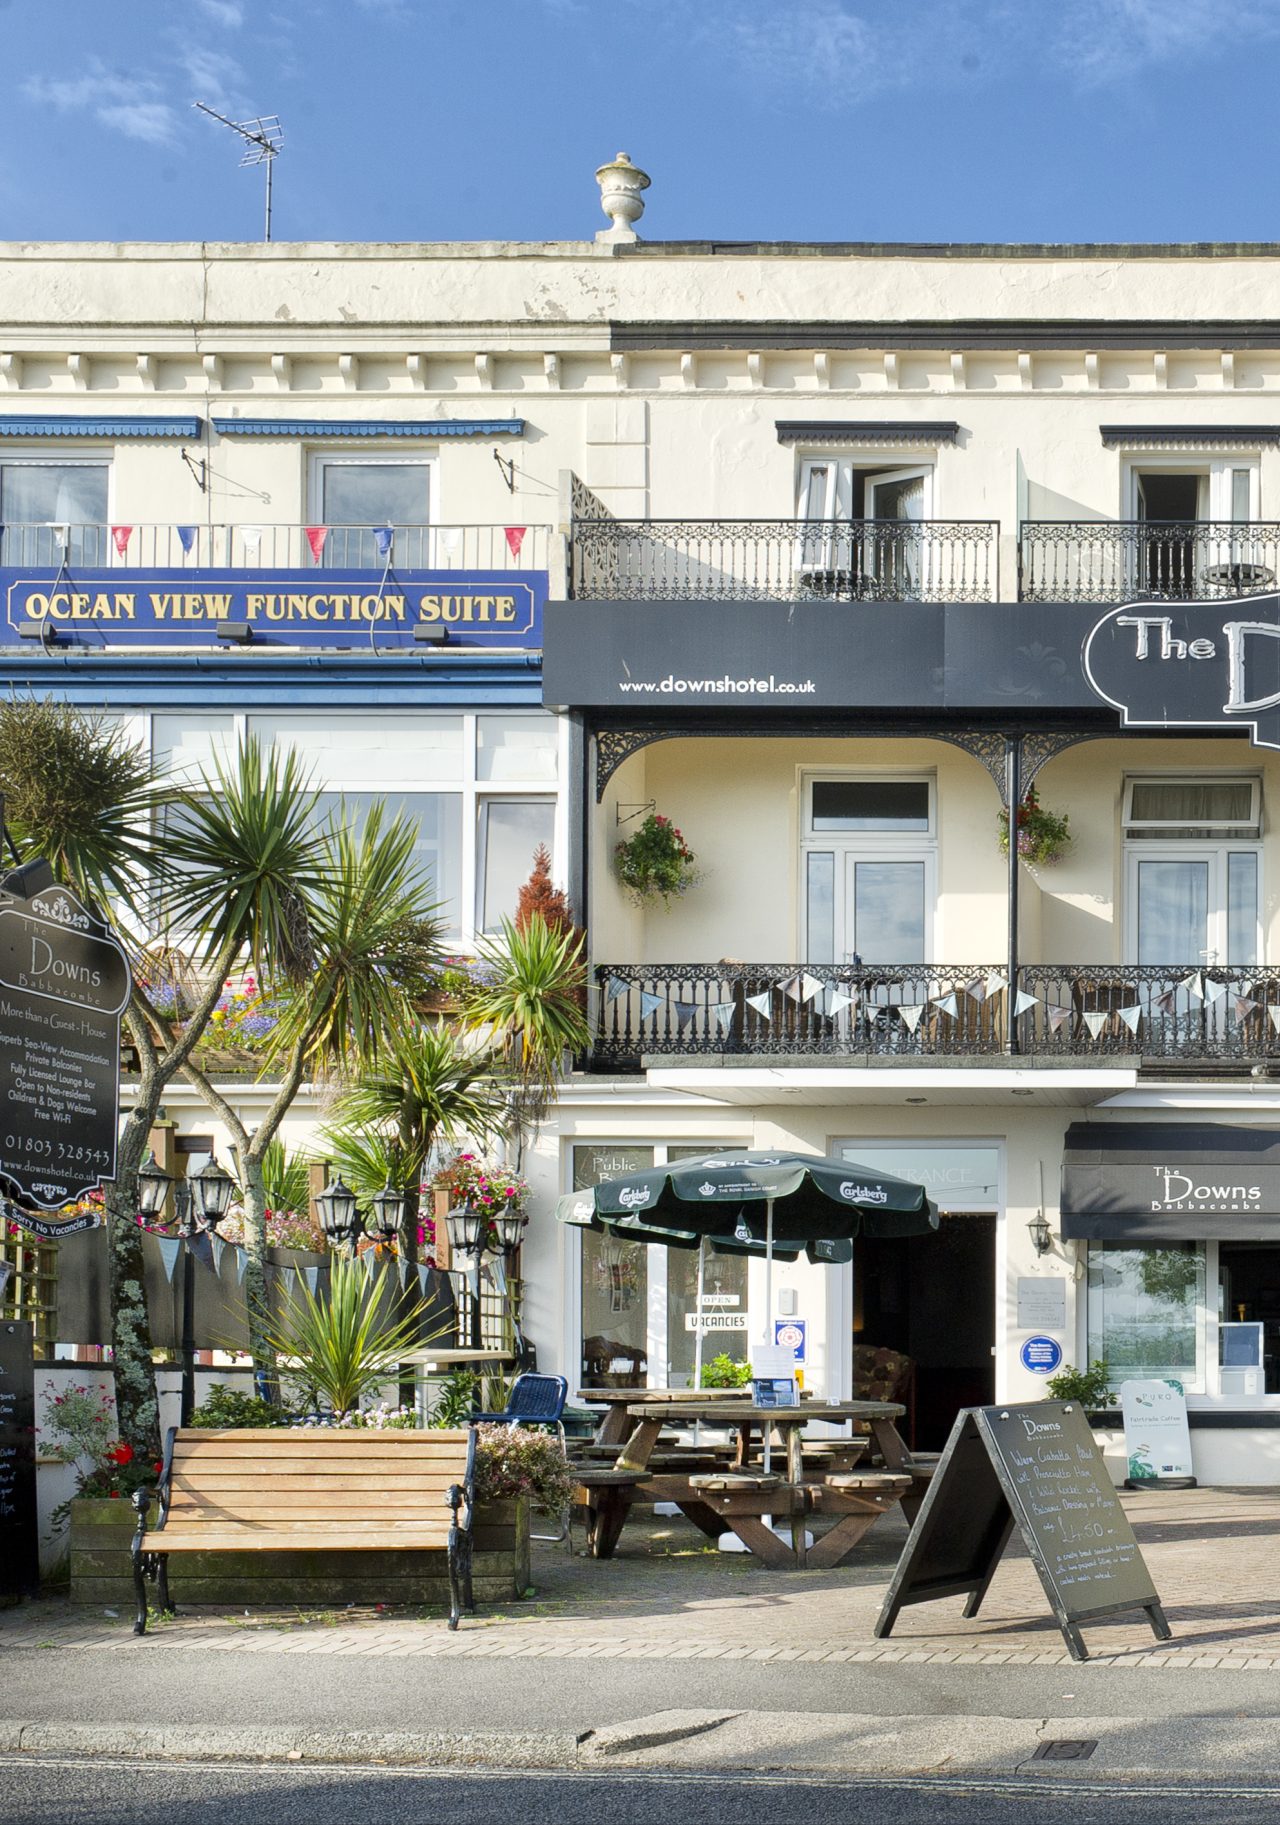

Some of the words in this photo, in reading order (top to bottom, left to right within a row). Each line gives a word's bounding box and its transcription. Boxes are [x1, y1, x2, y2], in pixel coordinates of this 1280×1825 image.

[25, 593, 137, 621] OCEAN
[149, 594, 232, 621] VIEW
[246, 595, 406, 622] FUNCTION
[419, 595, 518, 624] SUITE
[1116, 614, 1217, 661] The
[618, 674, 816, 695] www.downshotel.co.uk
[22, 918, 47, 936] The
[30, 936, 101, 987] Downs
[18, 972, 101, 1005] Babbacombe
[0, 1000, 23, 1018] More
[25, 1007, 42, 1022] than
[81, 1020, 107, 1039] House
[24, 1036, 58, 1053] Sea-View
[59, 1046, 110, 1066] Accommodation
[25, 1051, 50, 1066] Private
[51, 1058, 82, 1073] Balconies
[10, 1062, 27, 1077] Fully
[28, 1066, 57, 1081] Licensed
[59, 1073, 82, 1088] Lounge
[84, 1078, 96, 1089] Bar
[15, 1077, 36, 1090] Open
[37, 1083, 44, 1092] to
[46, 1084, 91, 1101] Non-residents
[8, 1089, 37, 1104] Children
[38, 1095, 45, 1106] &
[47, 1097, 65, 1112] Dogs
[66, 1101, 97, 1116] Welcome
[34, 1108, 50, 1120] Free
[52, 1111, 72, 1124] Wi-Fi
[5, 1134, 52, 1157] 01803
[57, 1142, 110, 1167] 328543
[3, 1160, 96, 1182] www.downshotel.co.uk
[592, 1156, 637, 1173] Public
[889, 1167, 976, 1184] TRANCE
[1153, 1166, 1180, 1177] The
[839, 1181, 888, 1204] Carlsberg
[1163, 1175, 1262, 1203] Downs
[1151, 1200, 1261, 1211] Babbacombe
[12, 1208, 34, 1231] Sorry
[35, 1222, 48, 1234] No
[49, 1219, 87, 1236] Vacancies
[703, 1296, 732, 1304] OPEN
[1141, 1393, 1172, 1401] PURO
[1022, 1419, 1061, 1436] Downs
